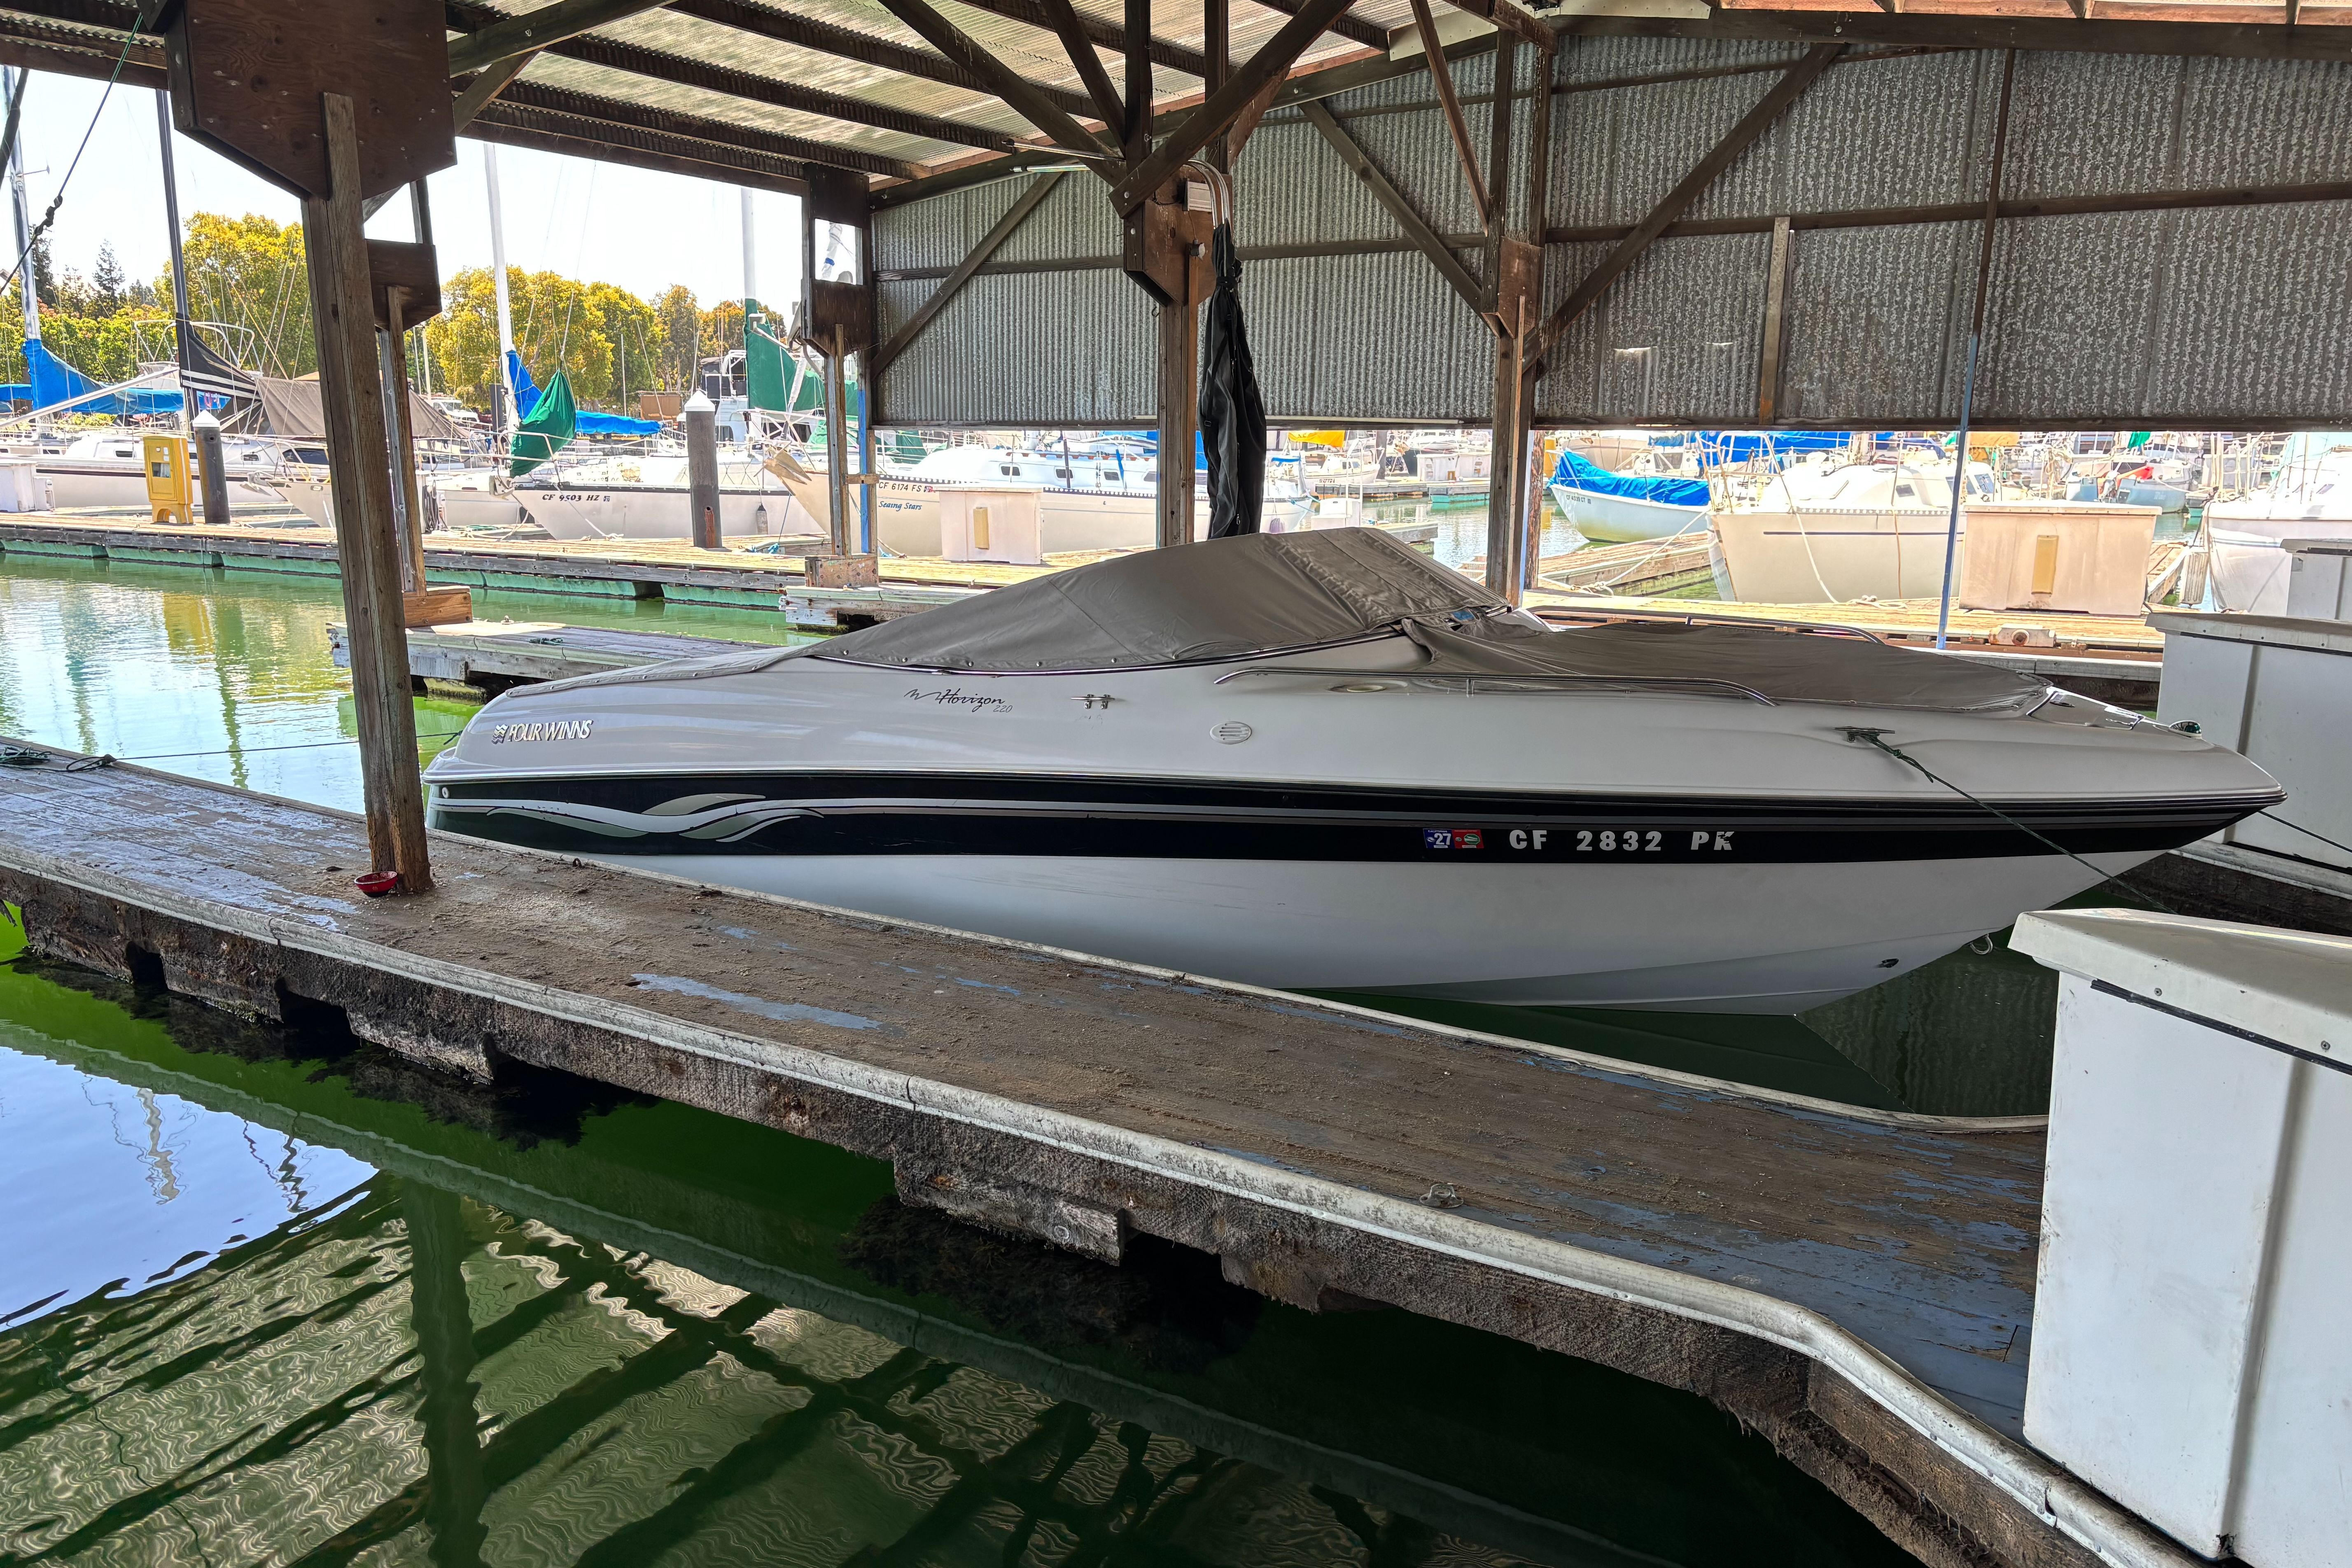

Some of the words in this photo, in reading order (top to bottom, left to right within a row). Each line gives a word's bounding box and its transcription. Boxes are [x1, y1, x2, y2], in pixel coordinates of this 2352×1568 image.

[938, 688, 1005, 712] Horizon
[508, 723, 543, 742] FOUR
[545, 719, 594, 741] WINNS
[1434, 833, 1451, 845] 27
[1509, 830, 1547, 849] CF
[1576, 831, 1662, 851] 2832
[1691, 831, 1734, 850] PK
